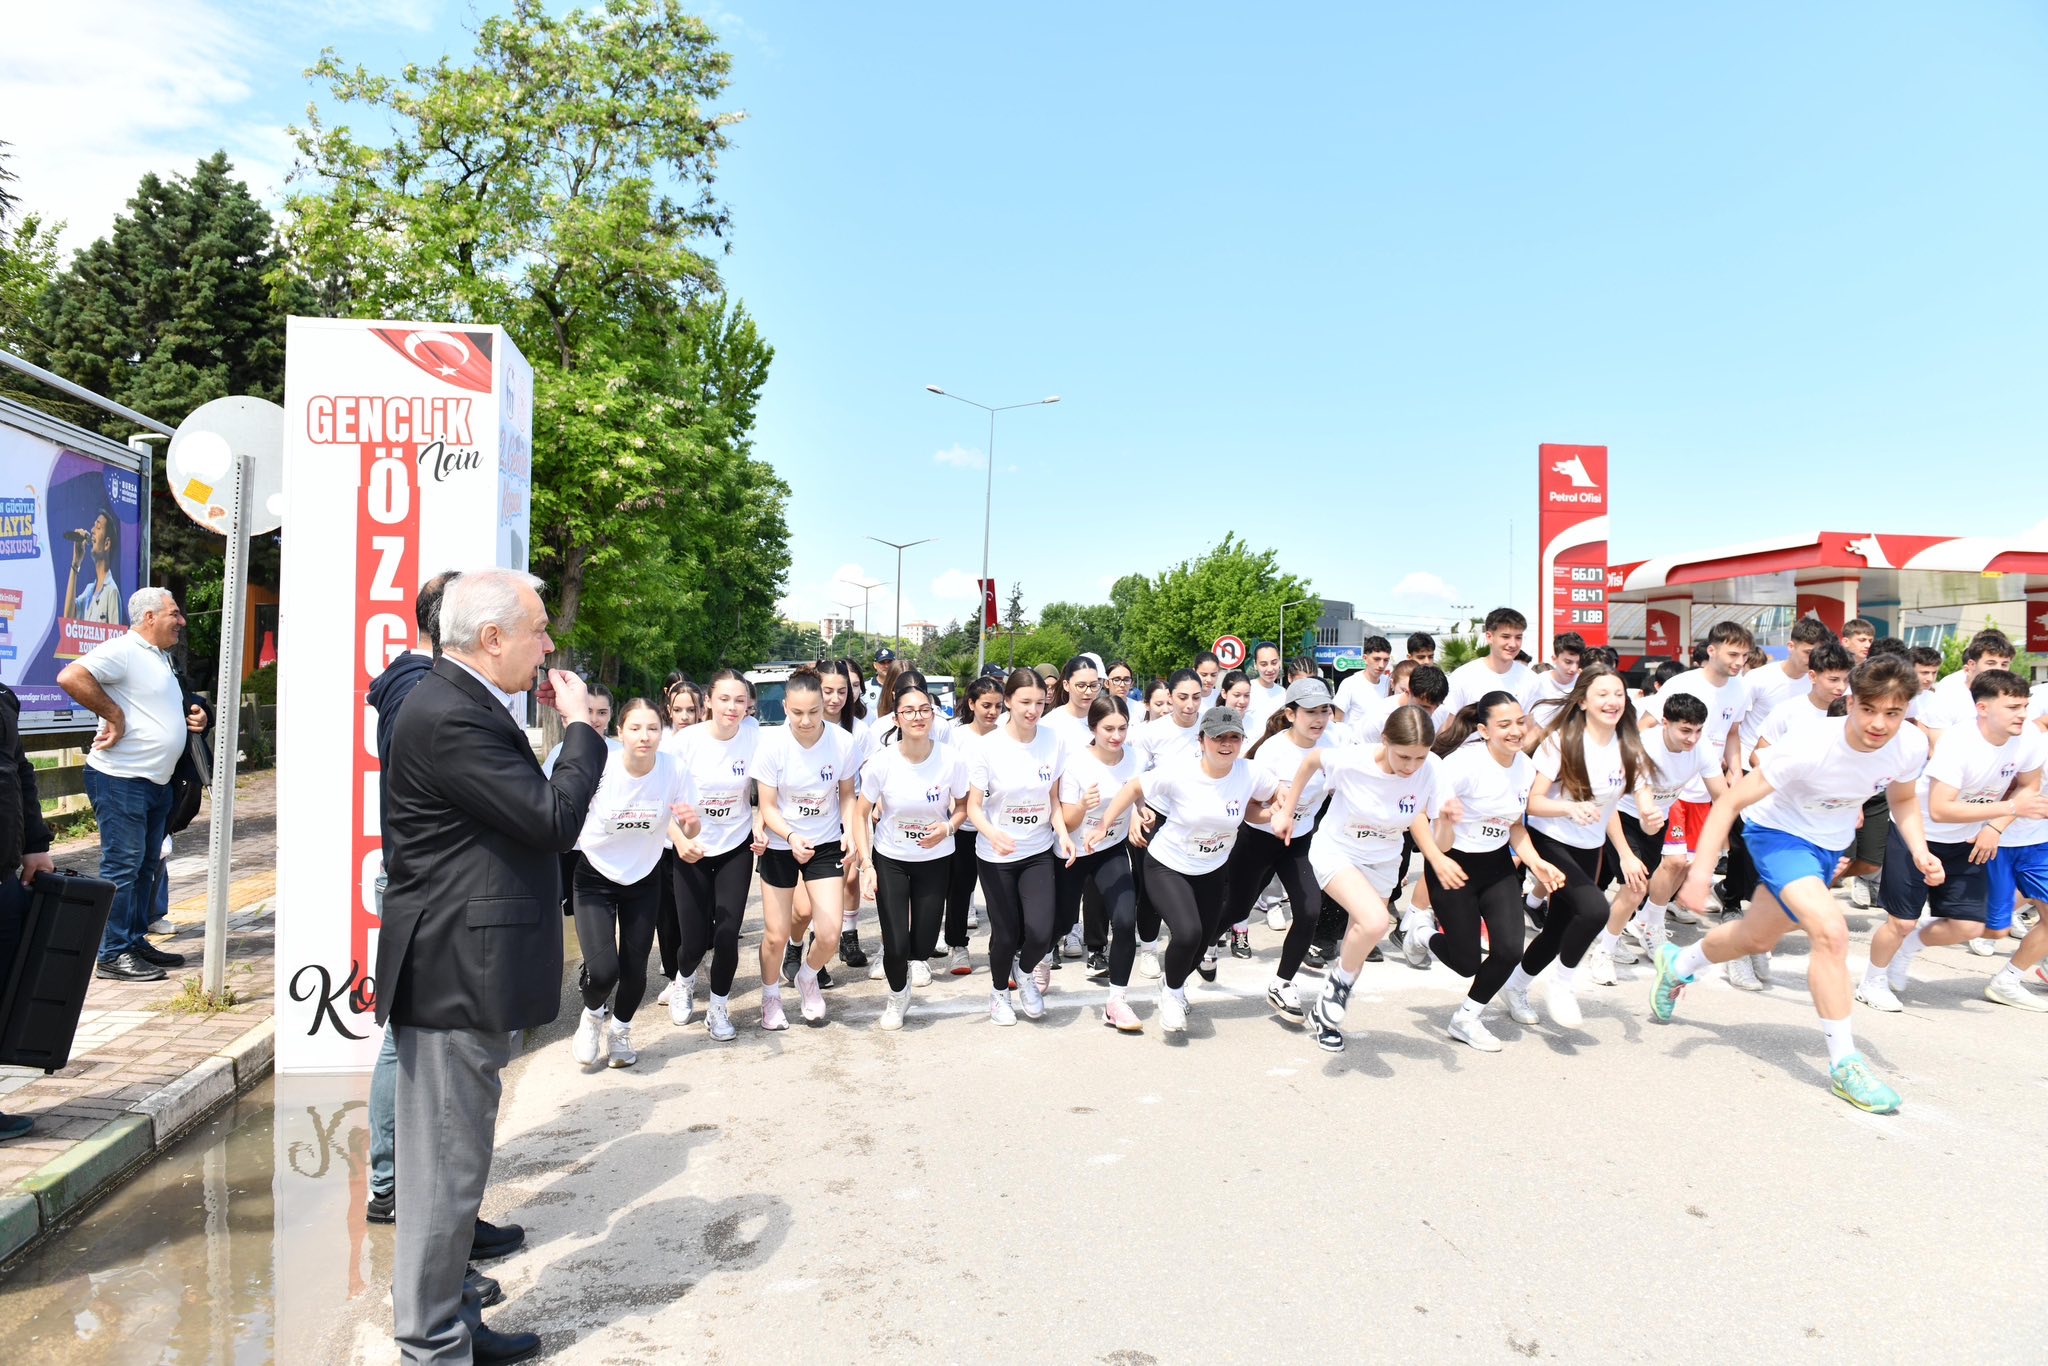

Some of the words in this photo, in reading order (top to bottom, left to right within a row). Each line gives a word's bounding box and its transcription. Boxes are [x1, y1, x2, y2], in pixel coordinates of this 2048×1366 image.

[1550, 491, 1578, 502] Petrol
[1579, 493, 1602, 503] Ofisi
[1571, 568, 1603, 581] 66.07
[1571, 588, 1603, 602] 68.47
[65, 620, 106, 641] OĞUZHAN
[705, 807, 731, 818] 1907
[616, 821, 650, 830] 2035
[1011, 815, 1038, 825] 1950
[288, 959, 378, 1041] Ko
